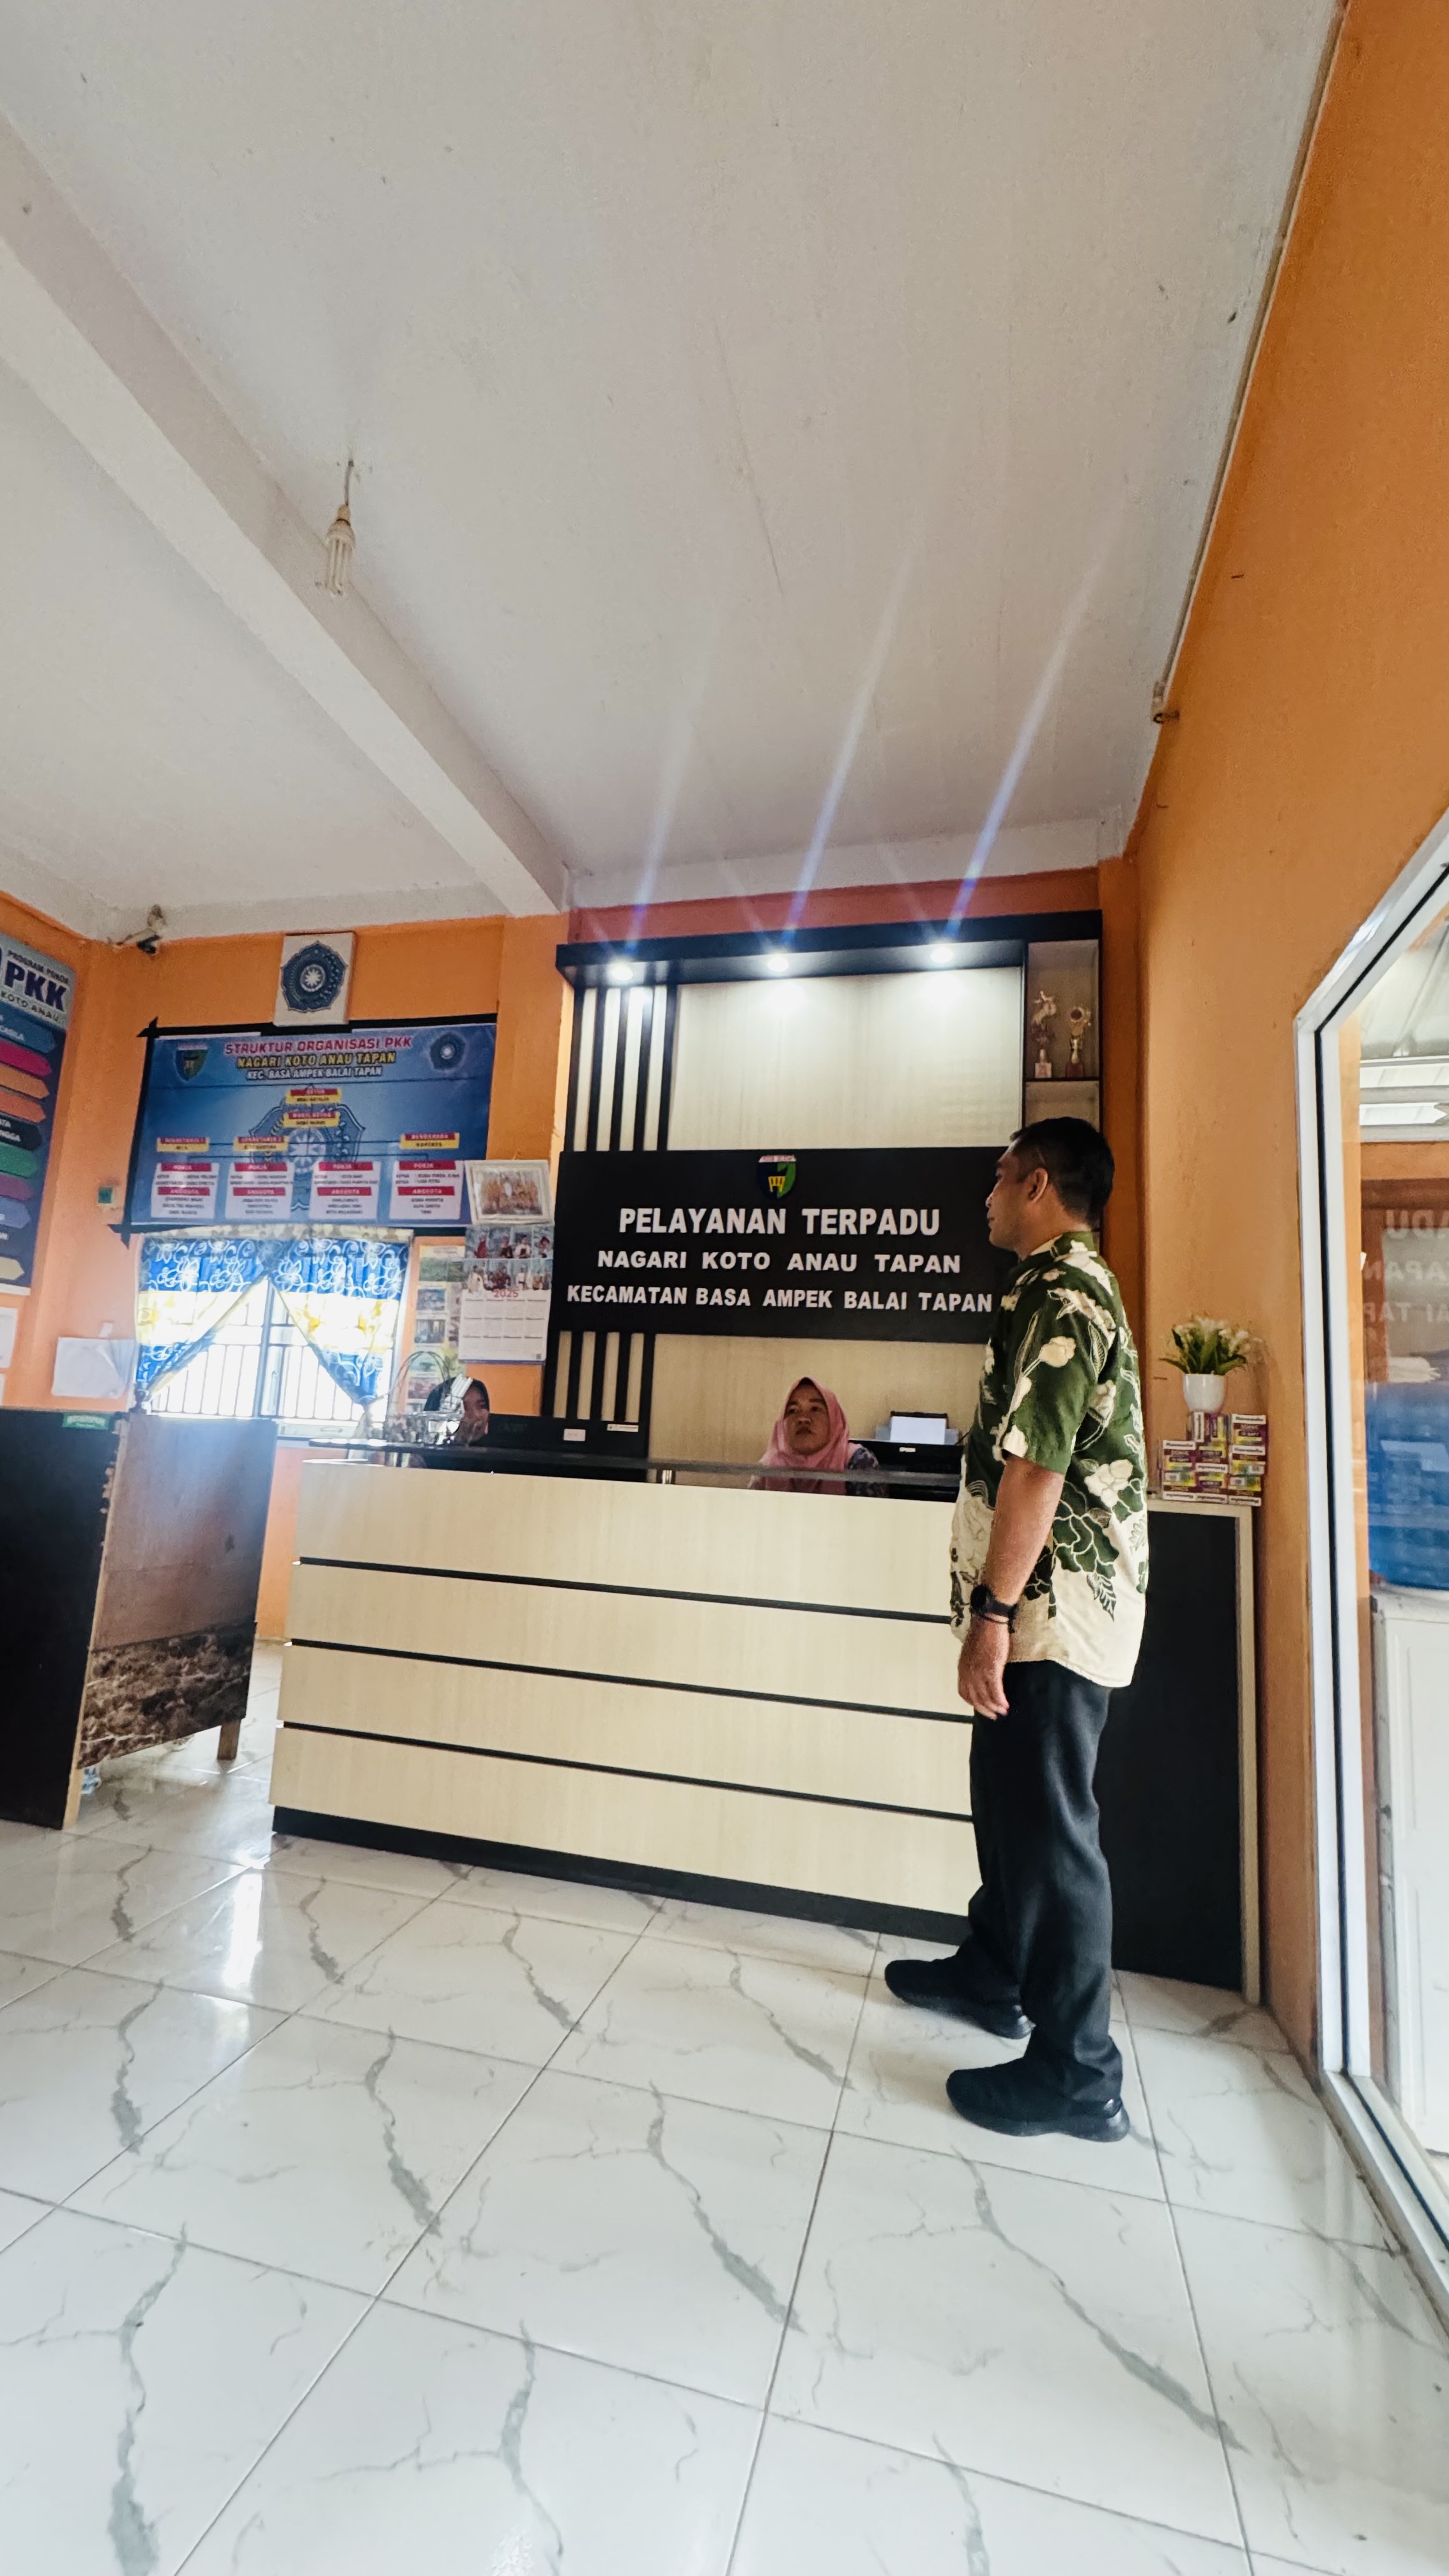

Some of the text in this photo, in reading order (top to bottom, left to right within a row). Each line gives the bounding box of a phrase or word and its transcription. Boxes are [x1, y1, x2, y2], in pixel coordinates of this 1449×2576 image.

[4, 960, 66, 1012] PKK
[1, 991, 59, 1021] KOTO ANAU
[226, 1036, 412, 1054] STRUKTUR ORGANISASI PKK
[237, 1052, 395, 1068] NAGARI KOTO ANAU TAPAN
[268, 1068, 291, 1079] BASA
[325, 1066, 351, 1077] BALAI
[354, 1065, 382, 1077] TAPAN
[619, 1208, 939, 1236] PELAYANAN TERPADU
[597, 1250, 960, 1273] NAGARI KOTO ANAU TAPAN
[494, 1289, 519, 1298] 2025
[567, 1285, 992, 1312] KECAMATAN BASA AMPEK BALAI TAPAN
